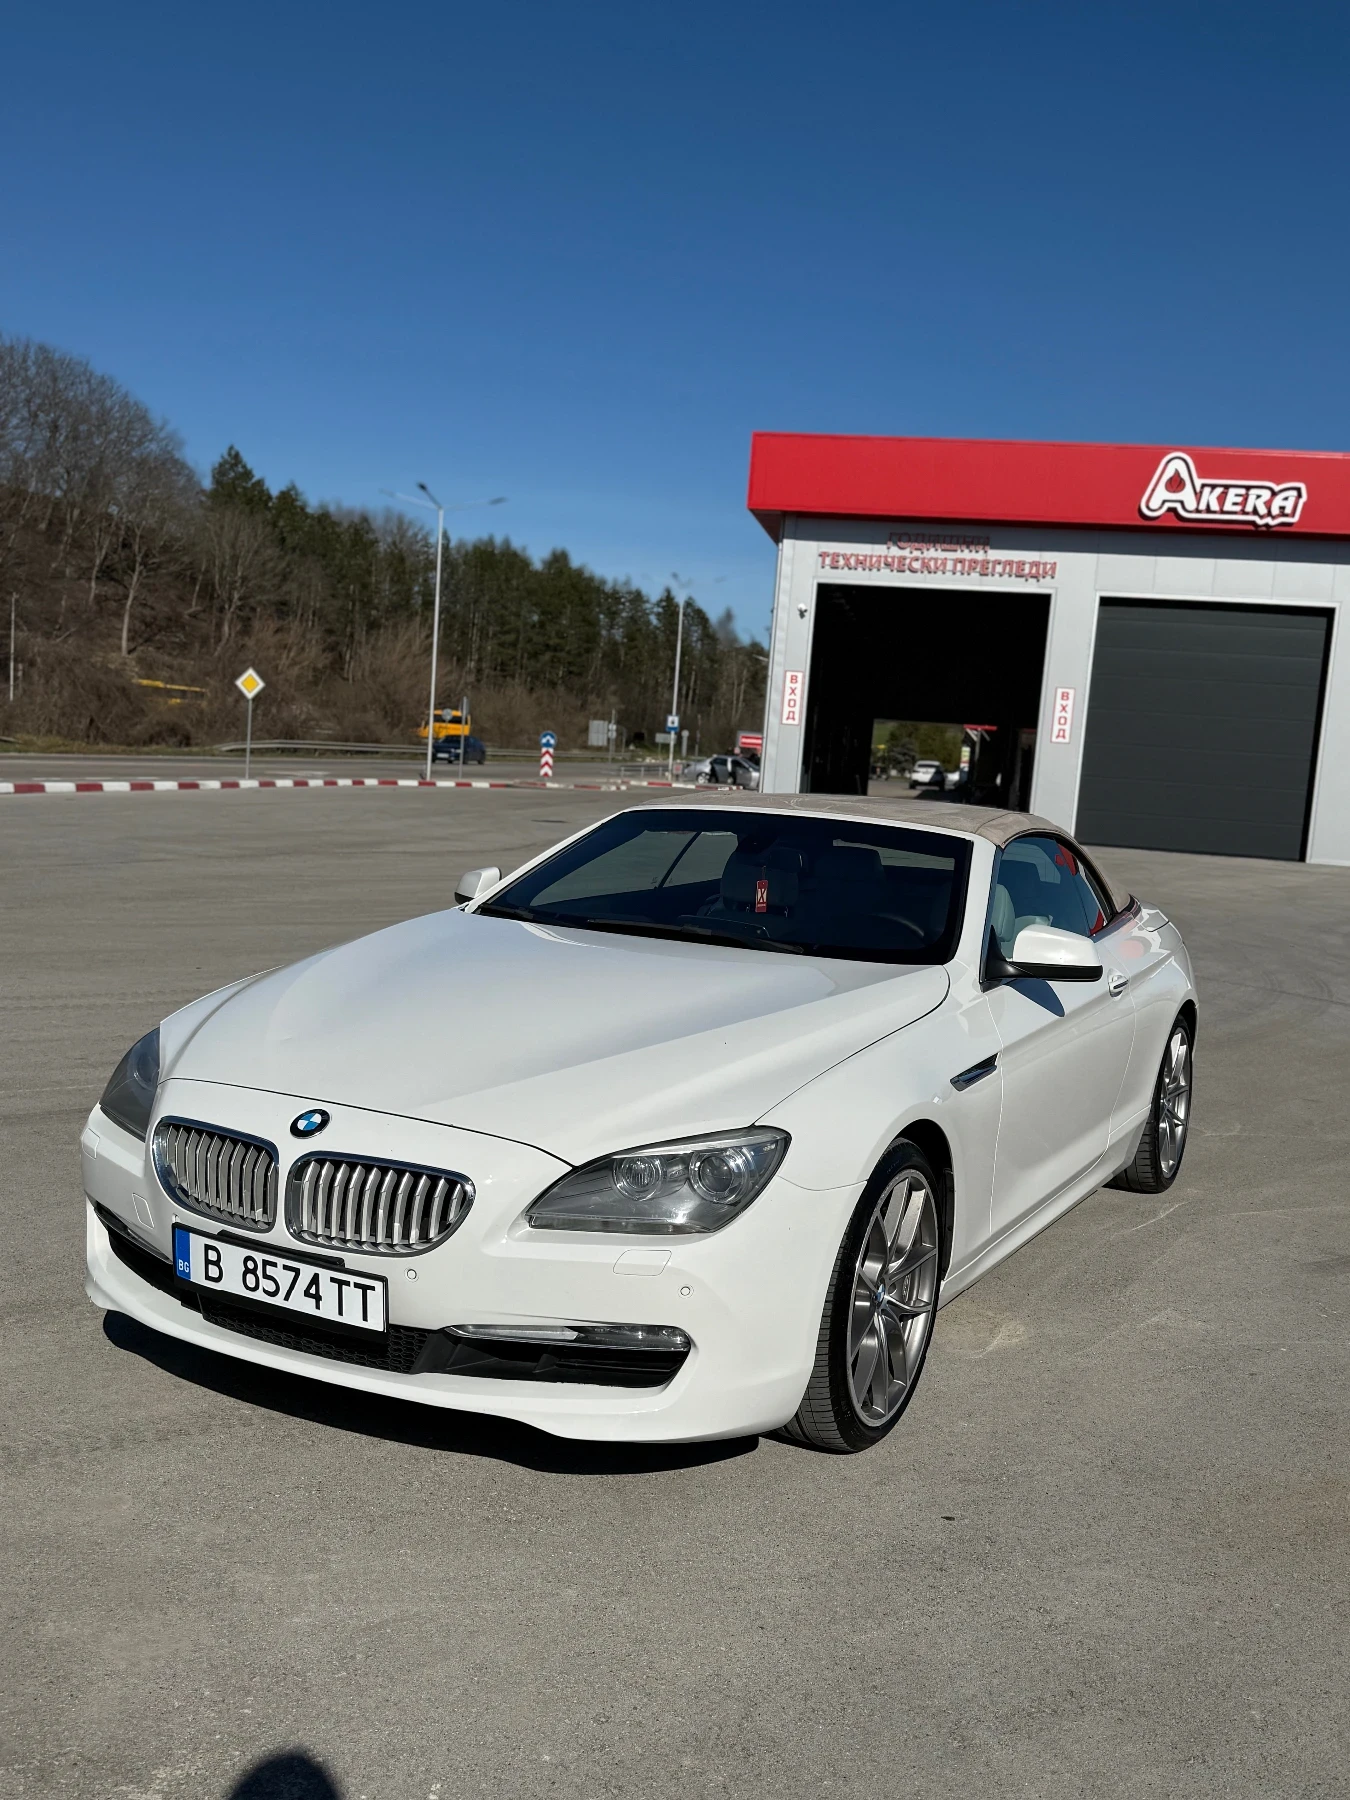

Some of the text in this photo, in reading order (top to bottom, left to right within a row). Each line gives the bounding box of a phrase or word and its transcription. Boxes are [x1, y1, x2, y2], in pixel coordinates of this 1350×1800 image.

[1147, 455, 1300, 519] AKERA
[887, 532, 990, 554] ГОДИШНИ
[818, 551, 1057, 581] ТЕХНИЧЕСКИ ПРЕГЛЕДИ
[786, 674, 798, 721] ВХОД
[1056, 691, 1070, 740] ВХОД
[178, 1259, 190, 1273] BG
[203, 1243, 224, 1283] B
